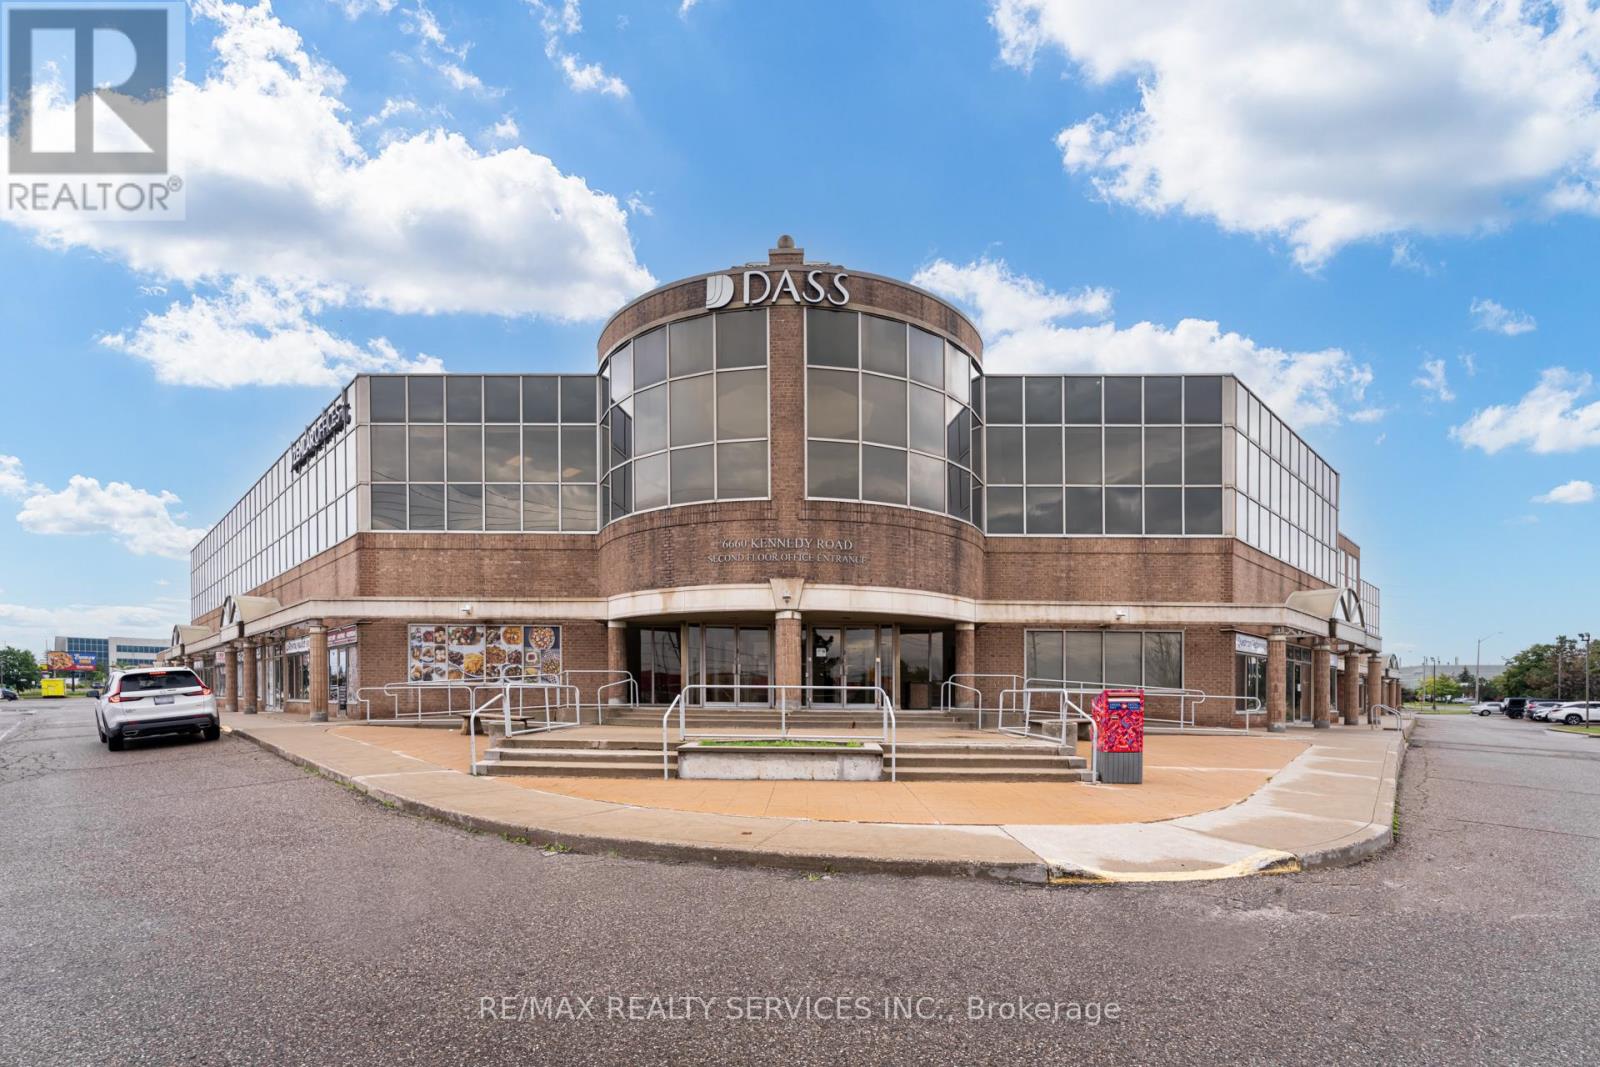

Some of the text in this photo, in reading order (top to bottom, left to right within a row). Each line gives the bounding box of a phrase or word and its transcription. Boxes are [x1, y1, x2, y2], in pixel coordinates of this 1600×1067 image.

[743, 269, 850, 306] DASS
[722, 538, 853, 550] 6660 KENNEDY ROAD
[708, 553, 867, 564] SECOND FLOOR OFFICE ENTRANCE
